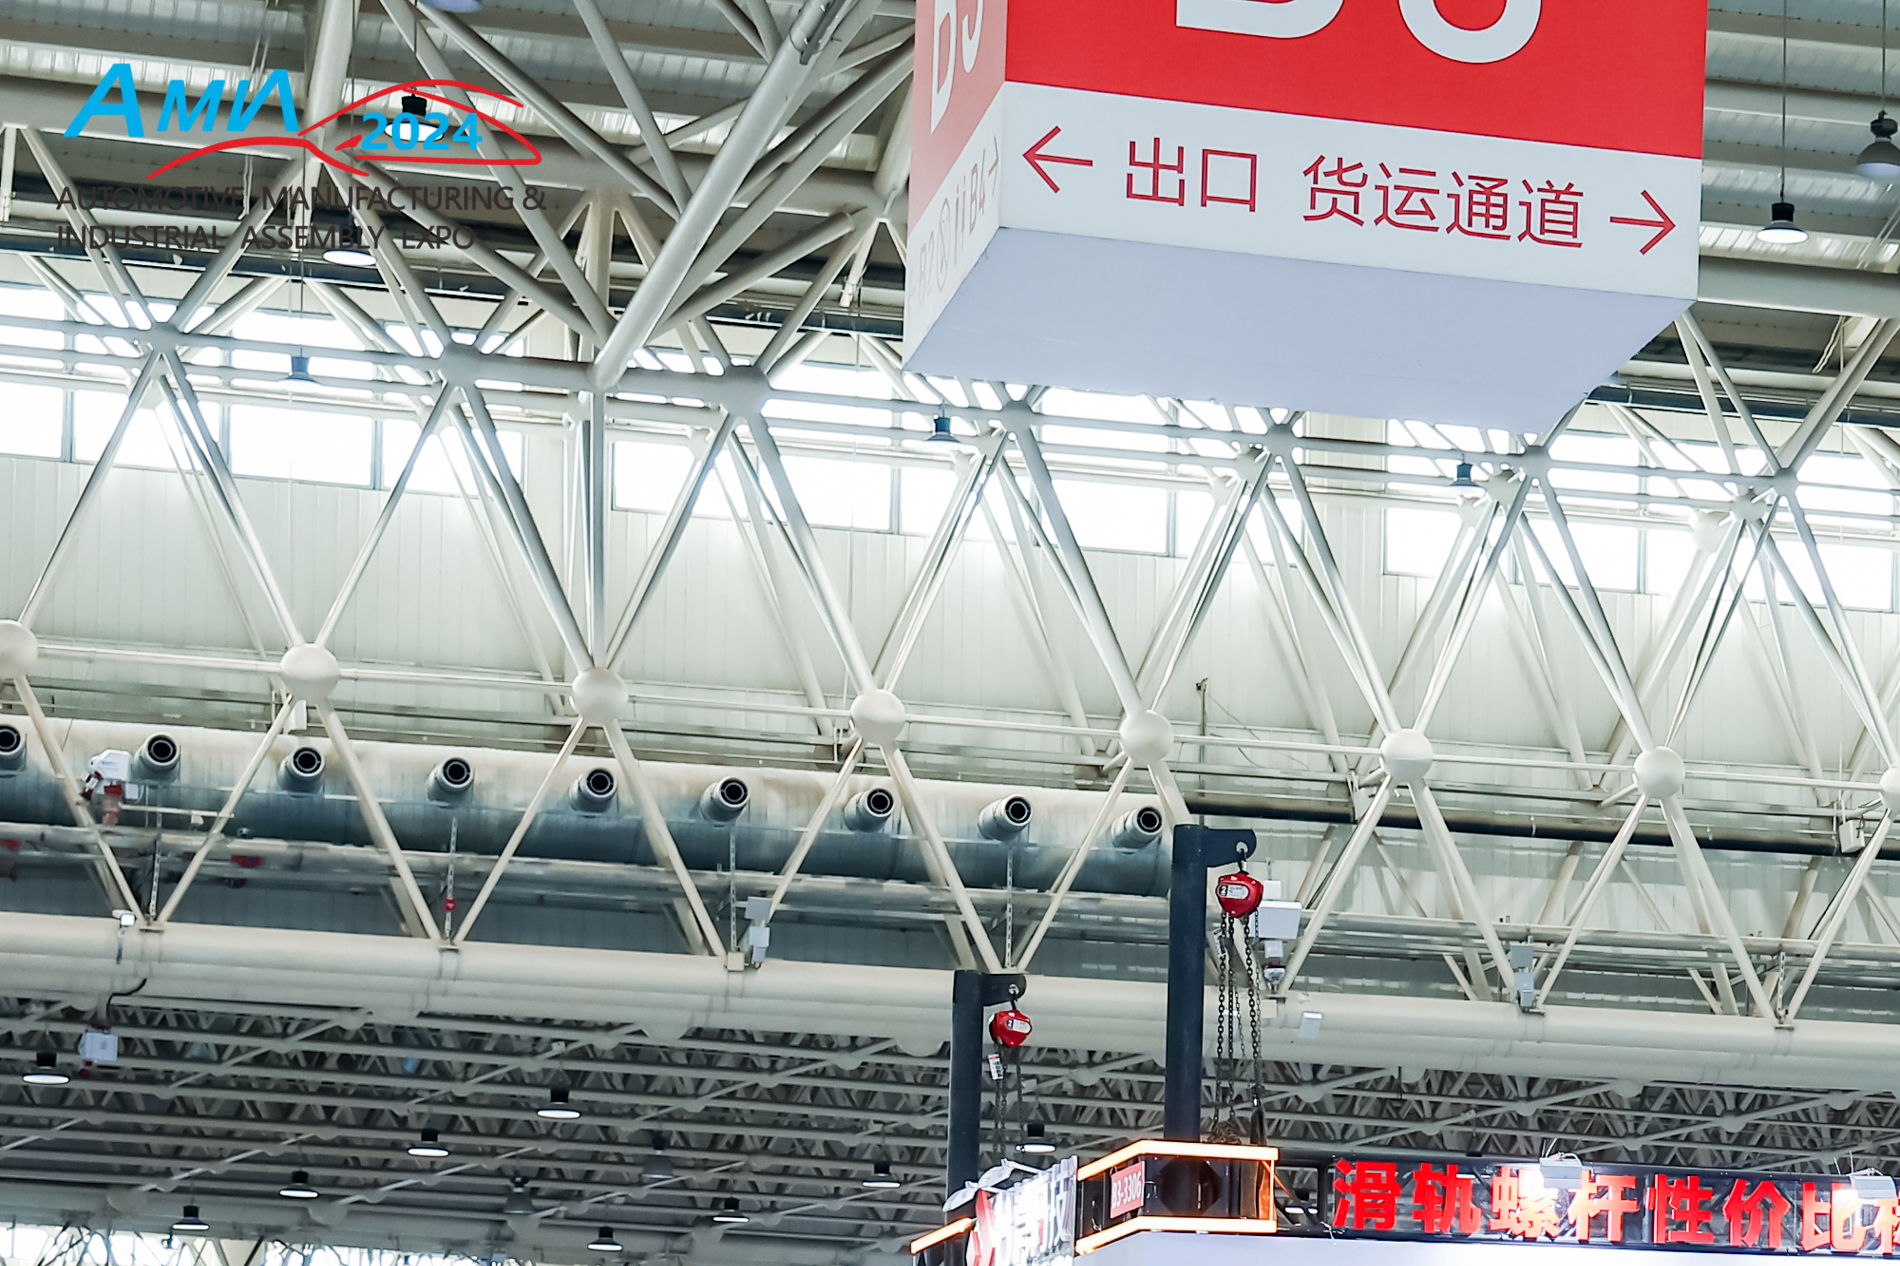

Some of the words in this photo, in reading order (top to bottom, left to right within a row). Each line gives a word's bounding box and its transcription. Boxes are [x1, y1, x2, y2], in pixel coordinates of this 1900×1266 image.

[1126, 138, 1258, 213] 出口
[1301, 154, 1584, 249] 货运通道
[1111, 1171, 1142, 1208] B3-3306
